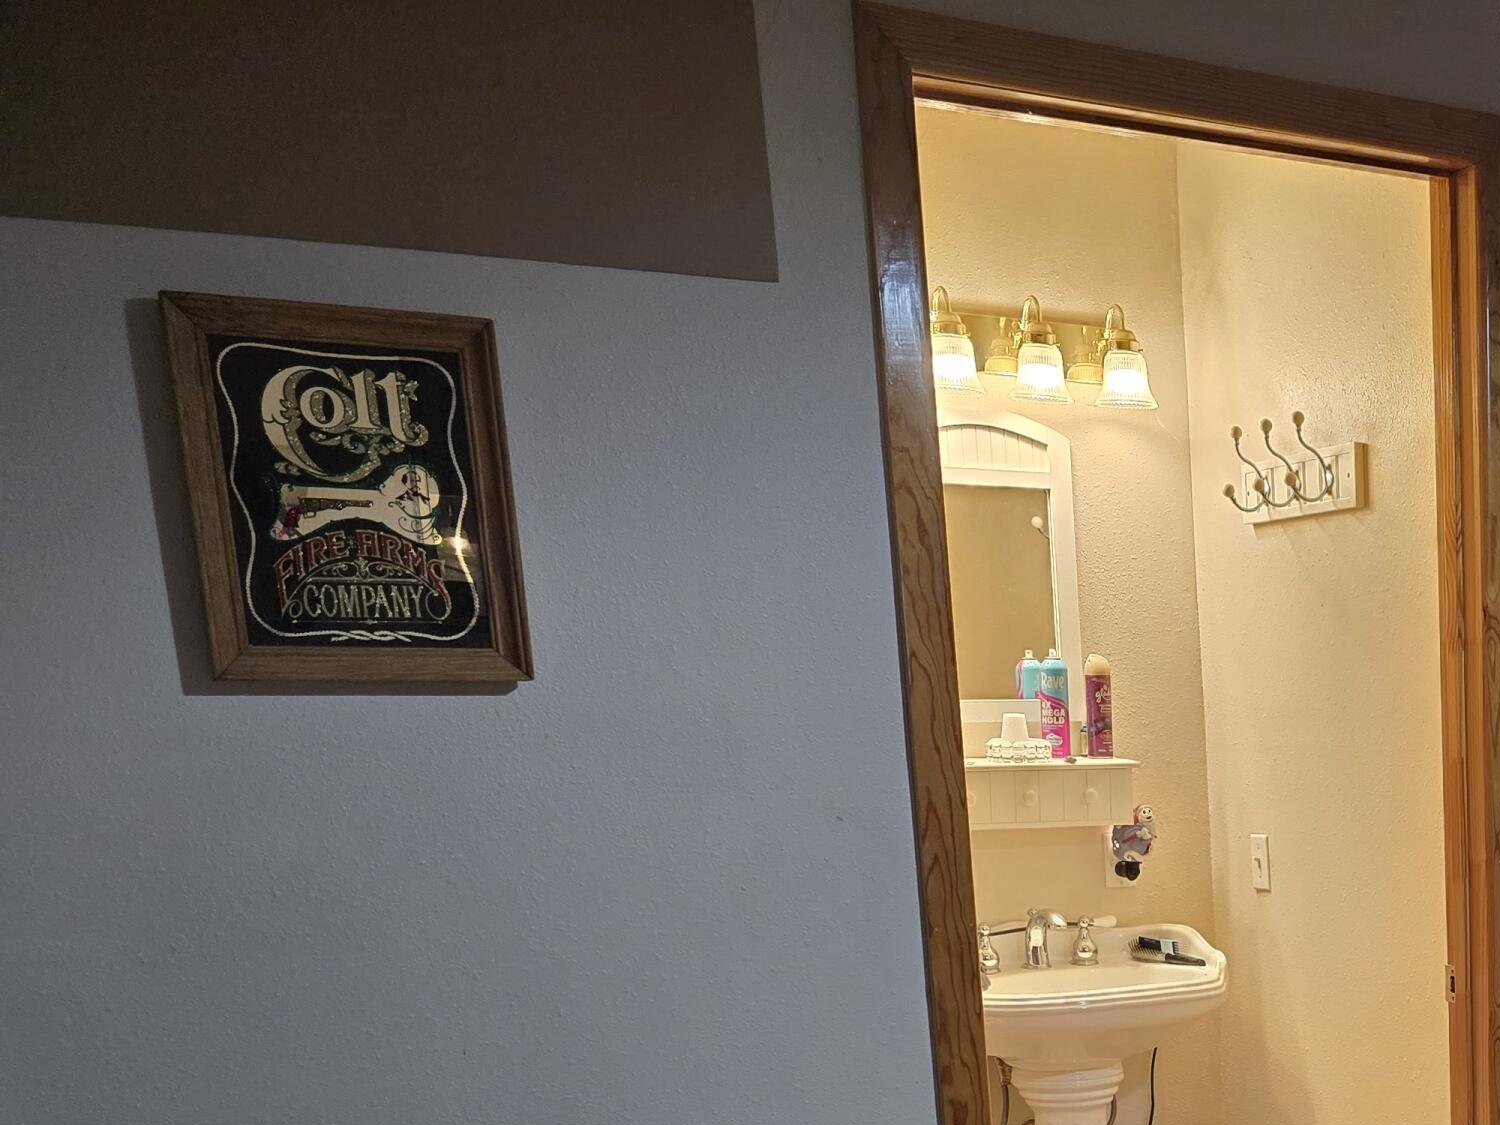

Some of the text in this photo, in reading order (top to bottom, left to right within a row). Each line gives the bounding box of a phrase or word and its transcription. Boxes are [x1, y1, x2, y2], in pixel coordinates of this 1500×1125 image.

[260, 364, 430, 483] Colt
[273, 529, 449, 617] FIRE ARMS
[303, 584, 424, 618] COMPANY
[1041, 672, 1065, 689] Rave
[1041, 708, 1065, 717] MEGA
[1042, 717, 1065, 725] HOLD
